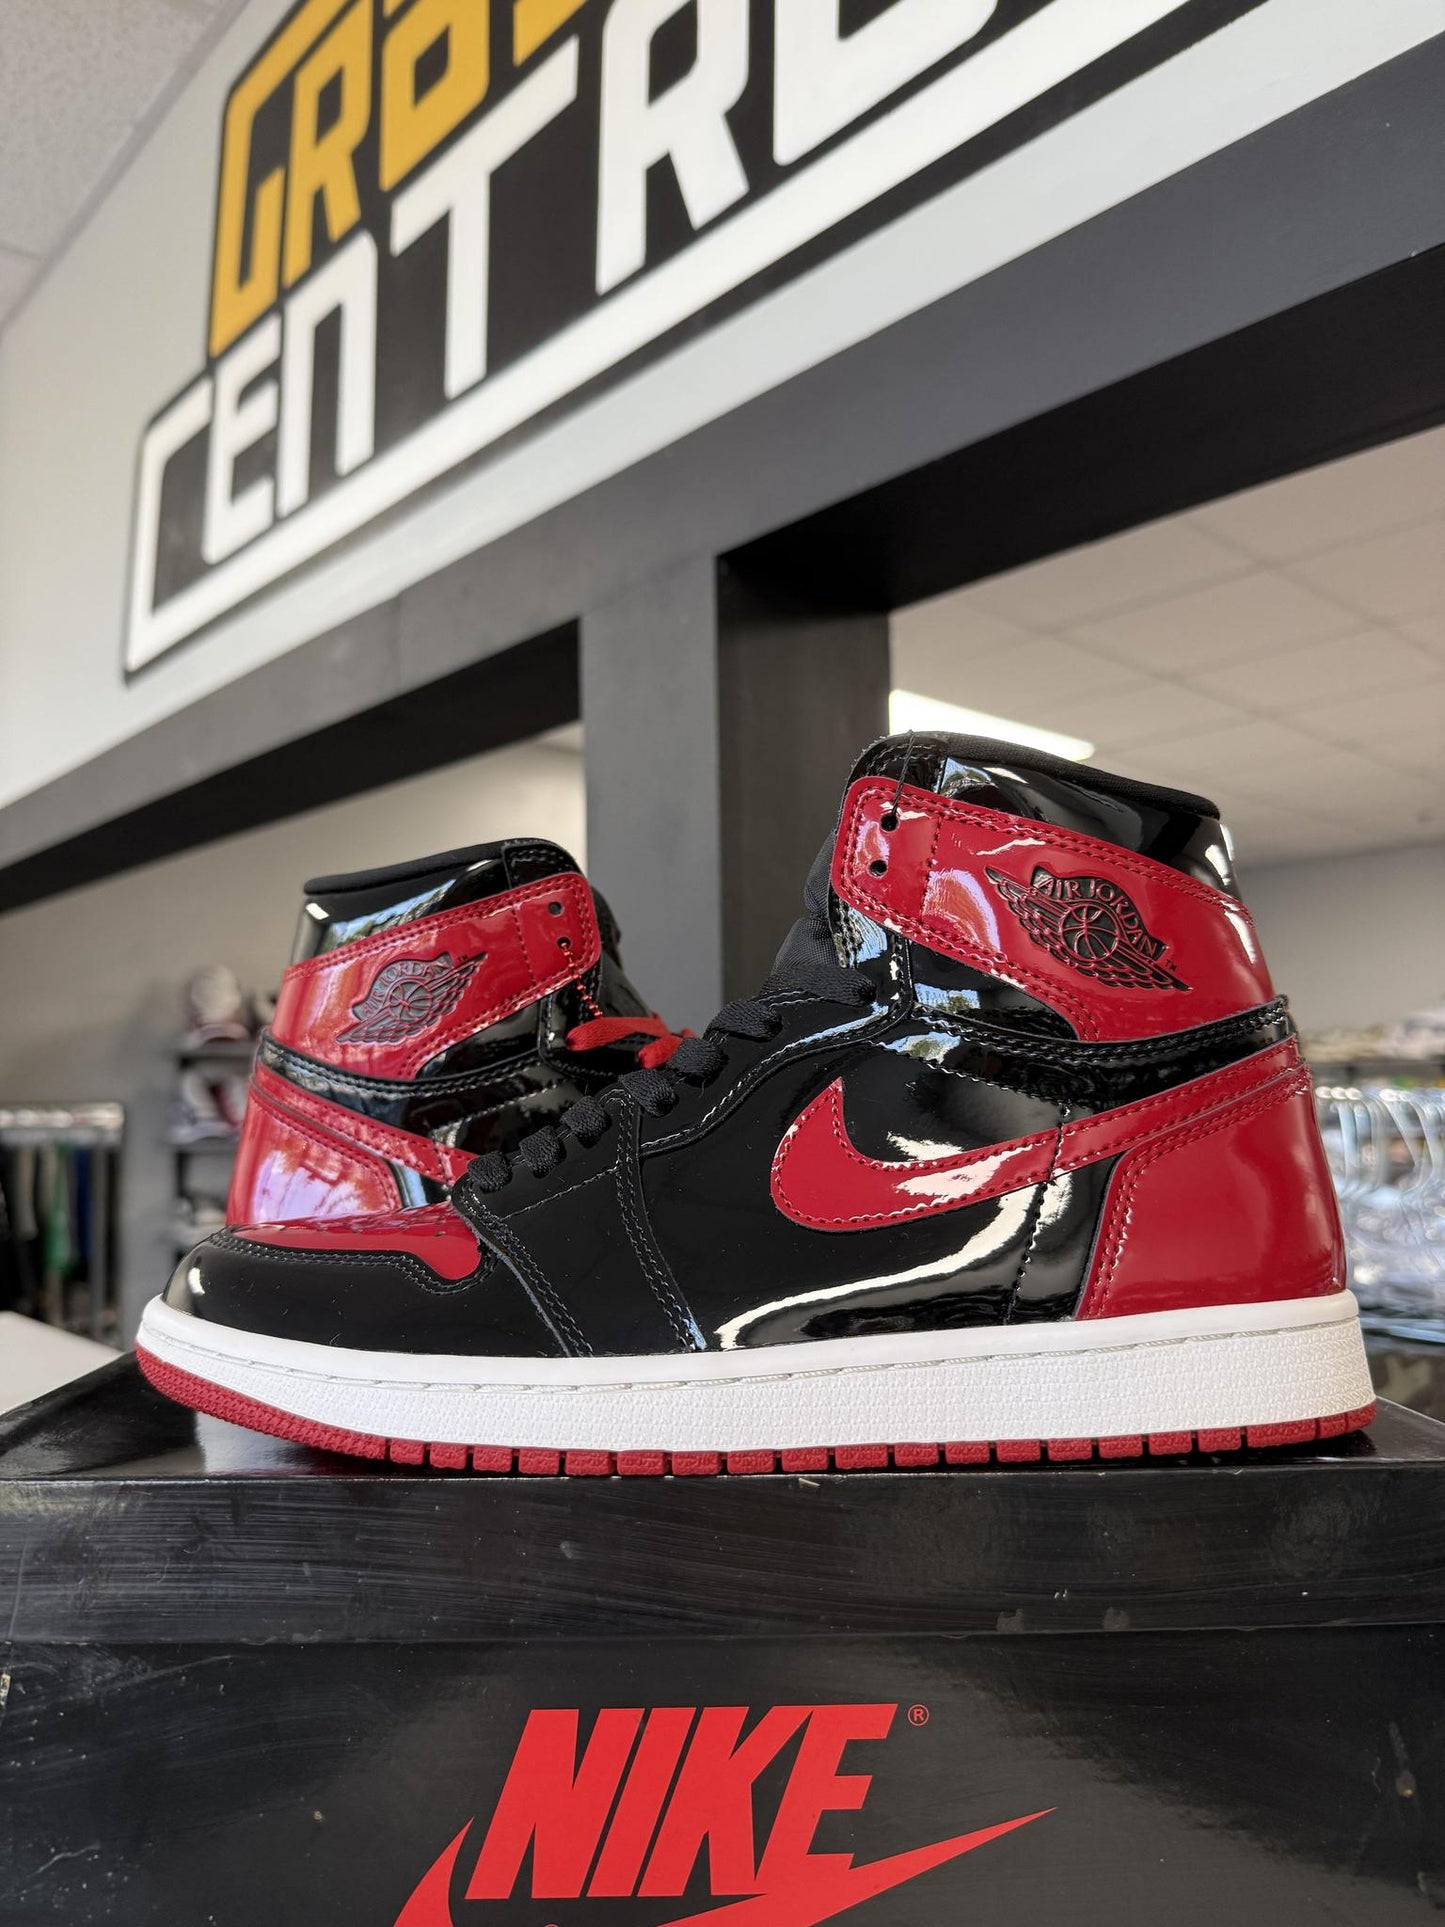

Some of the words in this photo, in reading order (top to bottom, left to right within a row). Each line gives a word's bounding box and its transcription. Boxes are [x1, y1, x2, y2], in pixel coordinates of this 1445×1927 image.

[1035, 876, 1083, 900] AIR
[1089, 878, 1158, 956] JORDAN
[379, 959, 450, 987] JORDAN
[464, 1703, 898, 1900] NIKE
